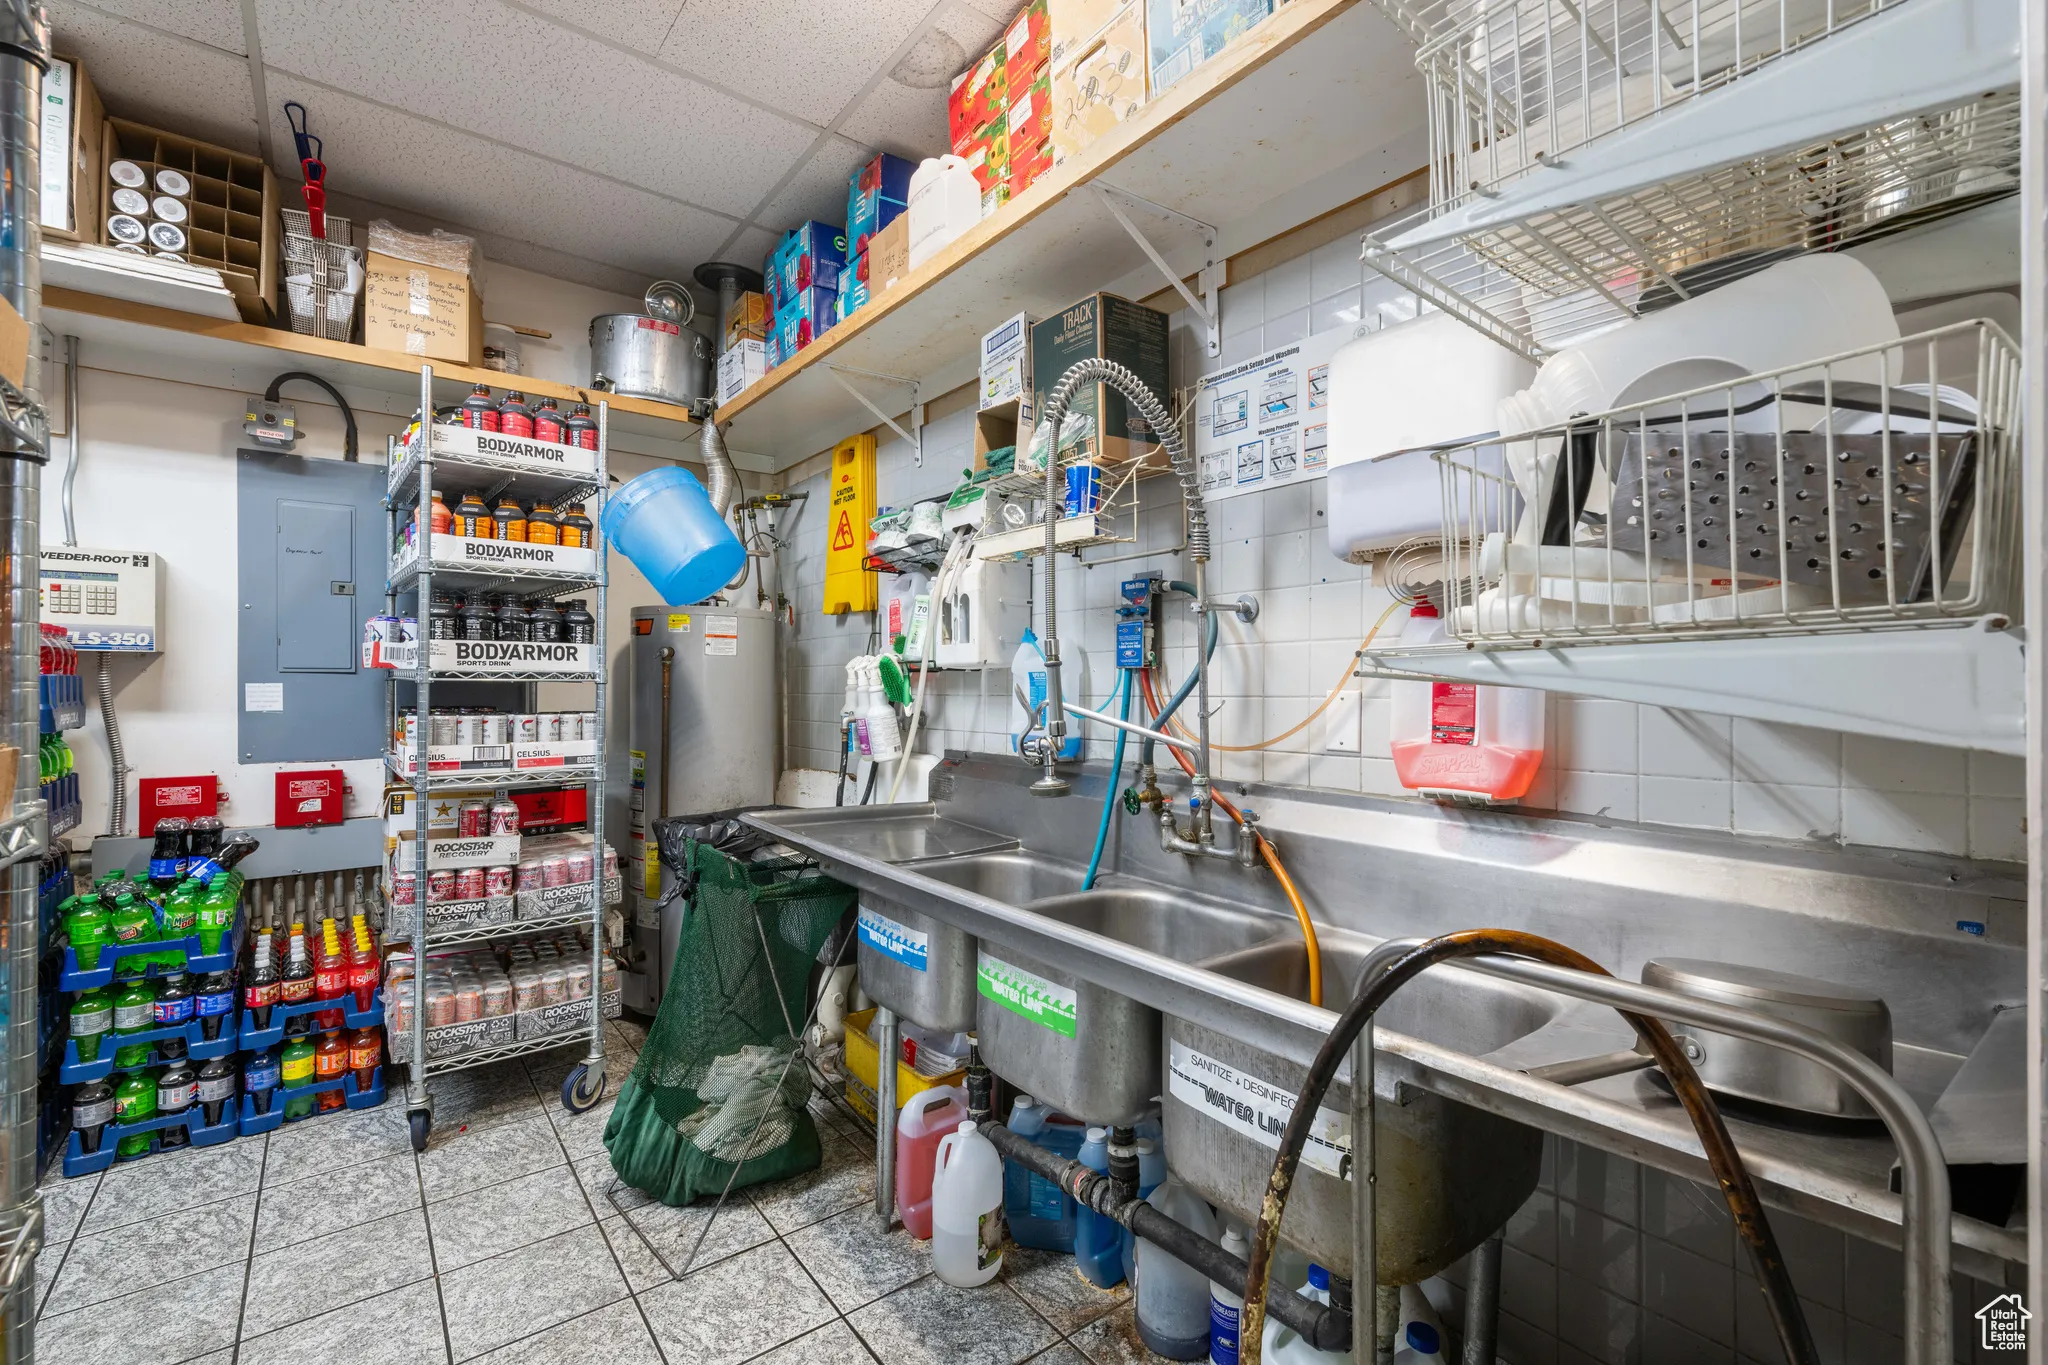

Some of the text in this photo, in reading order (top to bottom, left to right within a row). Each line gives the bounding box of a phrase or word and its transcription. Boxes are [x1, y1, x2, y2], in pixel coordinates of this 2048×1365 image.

[381, 287, 405, 297] Small
[1062, 302, 1092, 331] TRACK
[1237, 364, 1249, 374] Sink
[1248, 358, 1265, 370] Setup
[1264, 354, 1275, 363] and
[1274, 346, 1300, 360] Washing
[1258, 420, 1300, 436] Washing Procedures
[477, 436, 565, 463] BODYARMOR
[478, 448, 500, 457] SPORTS
[836, 485, 854, 497] CAUTION
[833, 493, 856, 506] WET FLOOR
[40, 551, 130, 563] VEEDER-ROOT
[465, 542, 554, 562] BODYARMOR
[917, 605, 928, 613] 70
[67, 631, 150, 645] LS-350
[455, 642, 578, 662] BODYARMOR
[408, 753, 446, 762] CSIUS
[517, 750, 551, 758] CELSIUS
[433, 841, 494, 853] ROCKSTAR
[439, 850, 490, 859] RECOVERY
[543, 884, 595, 899] ROCKSTAR
[556, 894, 583, 905] BOOM
[427, 902, 486, 916] ROCKSTAR
[439, 914, 470, 923] BOOM
[869, 929, 904, 956] WATER LINE
[992, 981, 1043, 1016] WATER LINE
[426, 1023, 487, 1042] ROCKSTAR
[438, 1034, 471, 1047] BOOM
[1190, 1054, 1299, 1112] SANITIZE DESINFEC
[1199, 1084, 1287, 1140] WATER LIN
